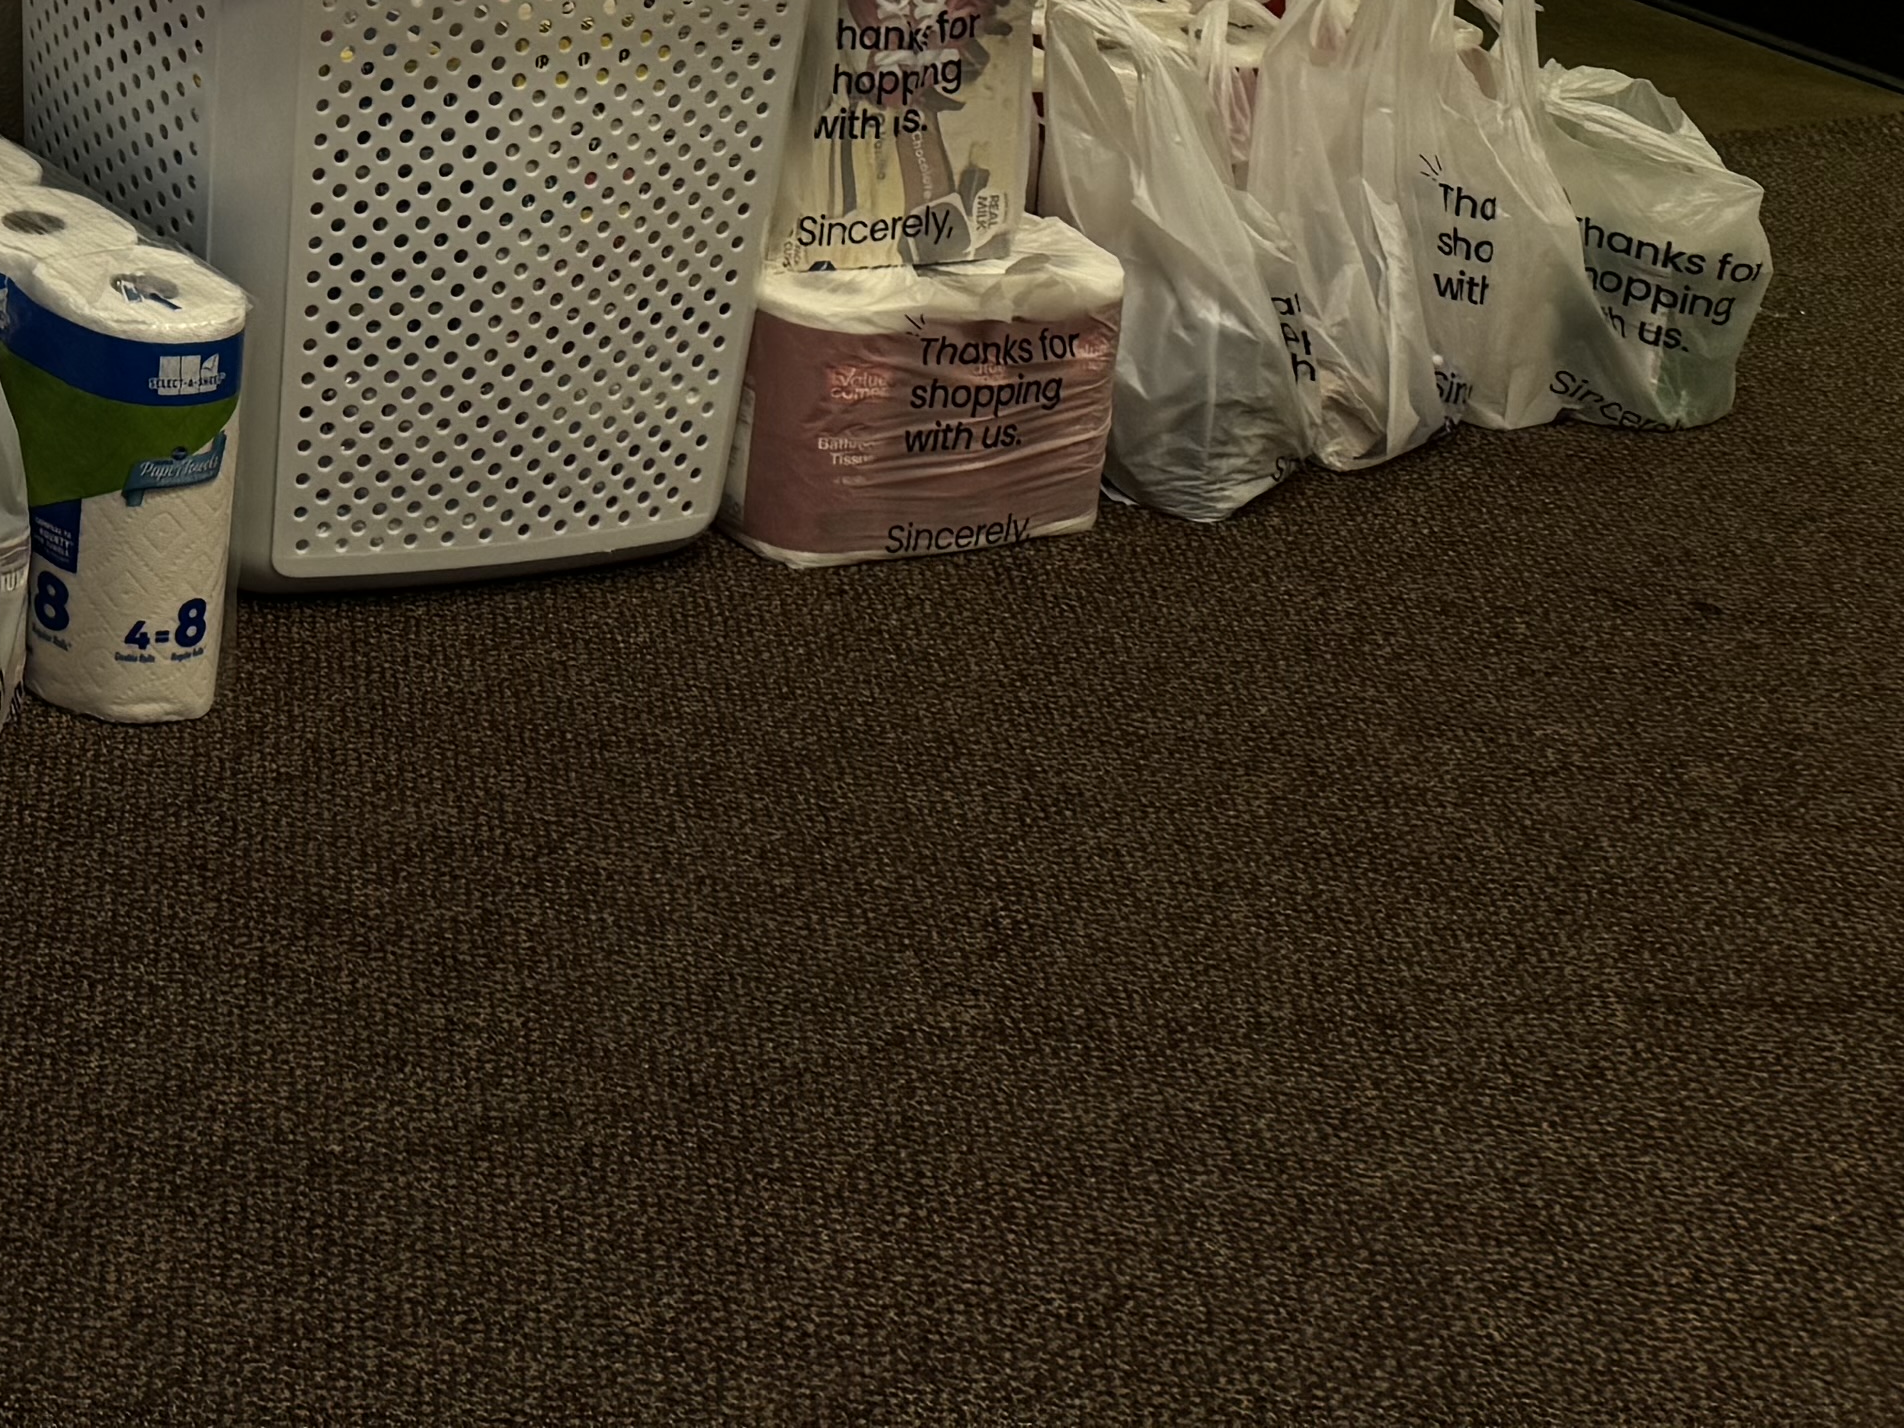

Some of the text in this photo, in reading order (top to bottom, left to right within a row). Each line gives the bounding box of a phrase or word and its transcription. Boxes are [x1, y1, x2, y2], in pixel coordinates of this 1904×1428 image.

[936, 9, 980, 41] for
[1438, 182, 1497, 221] Tha
[798, 206, 953, 246] Sincerely,
[1437, 227, 1494, 263] sho
[1576, 216, 1707, 275] hanks
[921, 327, 1080, 366] Thanks for
[1639, 321, 1689, 353] us.
[910, 373, 1063, 417] shopping
[905, 421, 1023, 453] with us.
